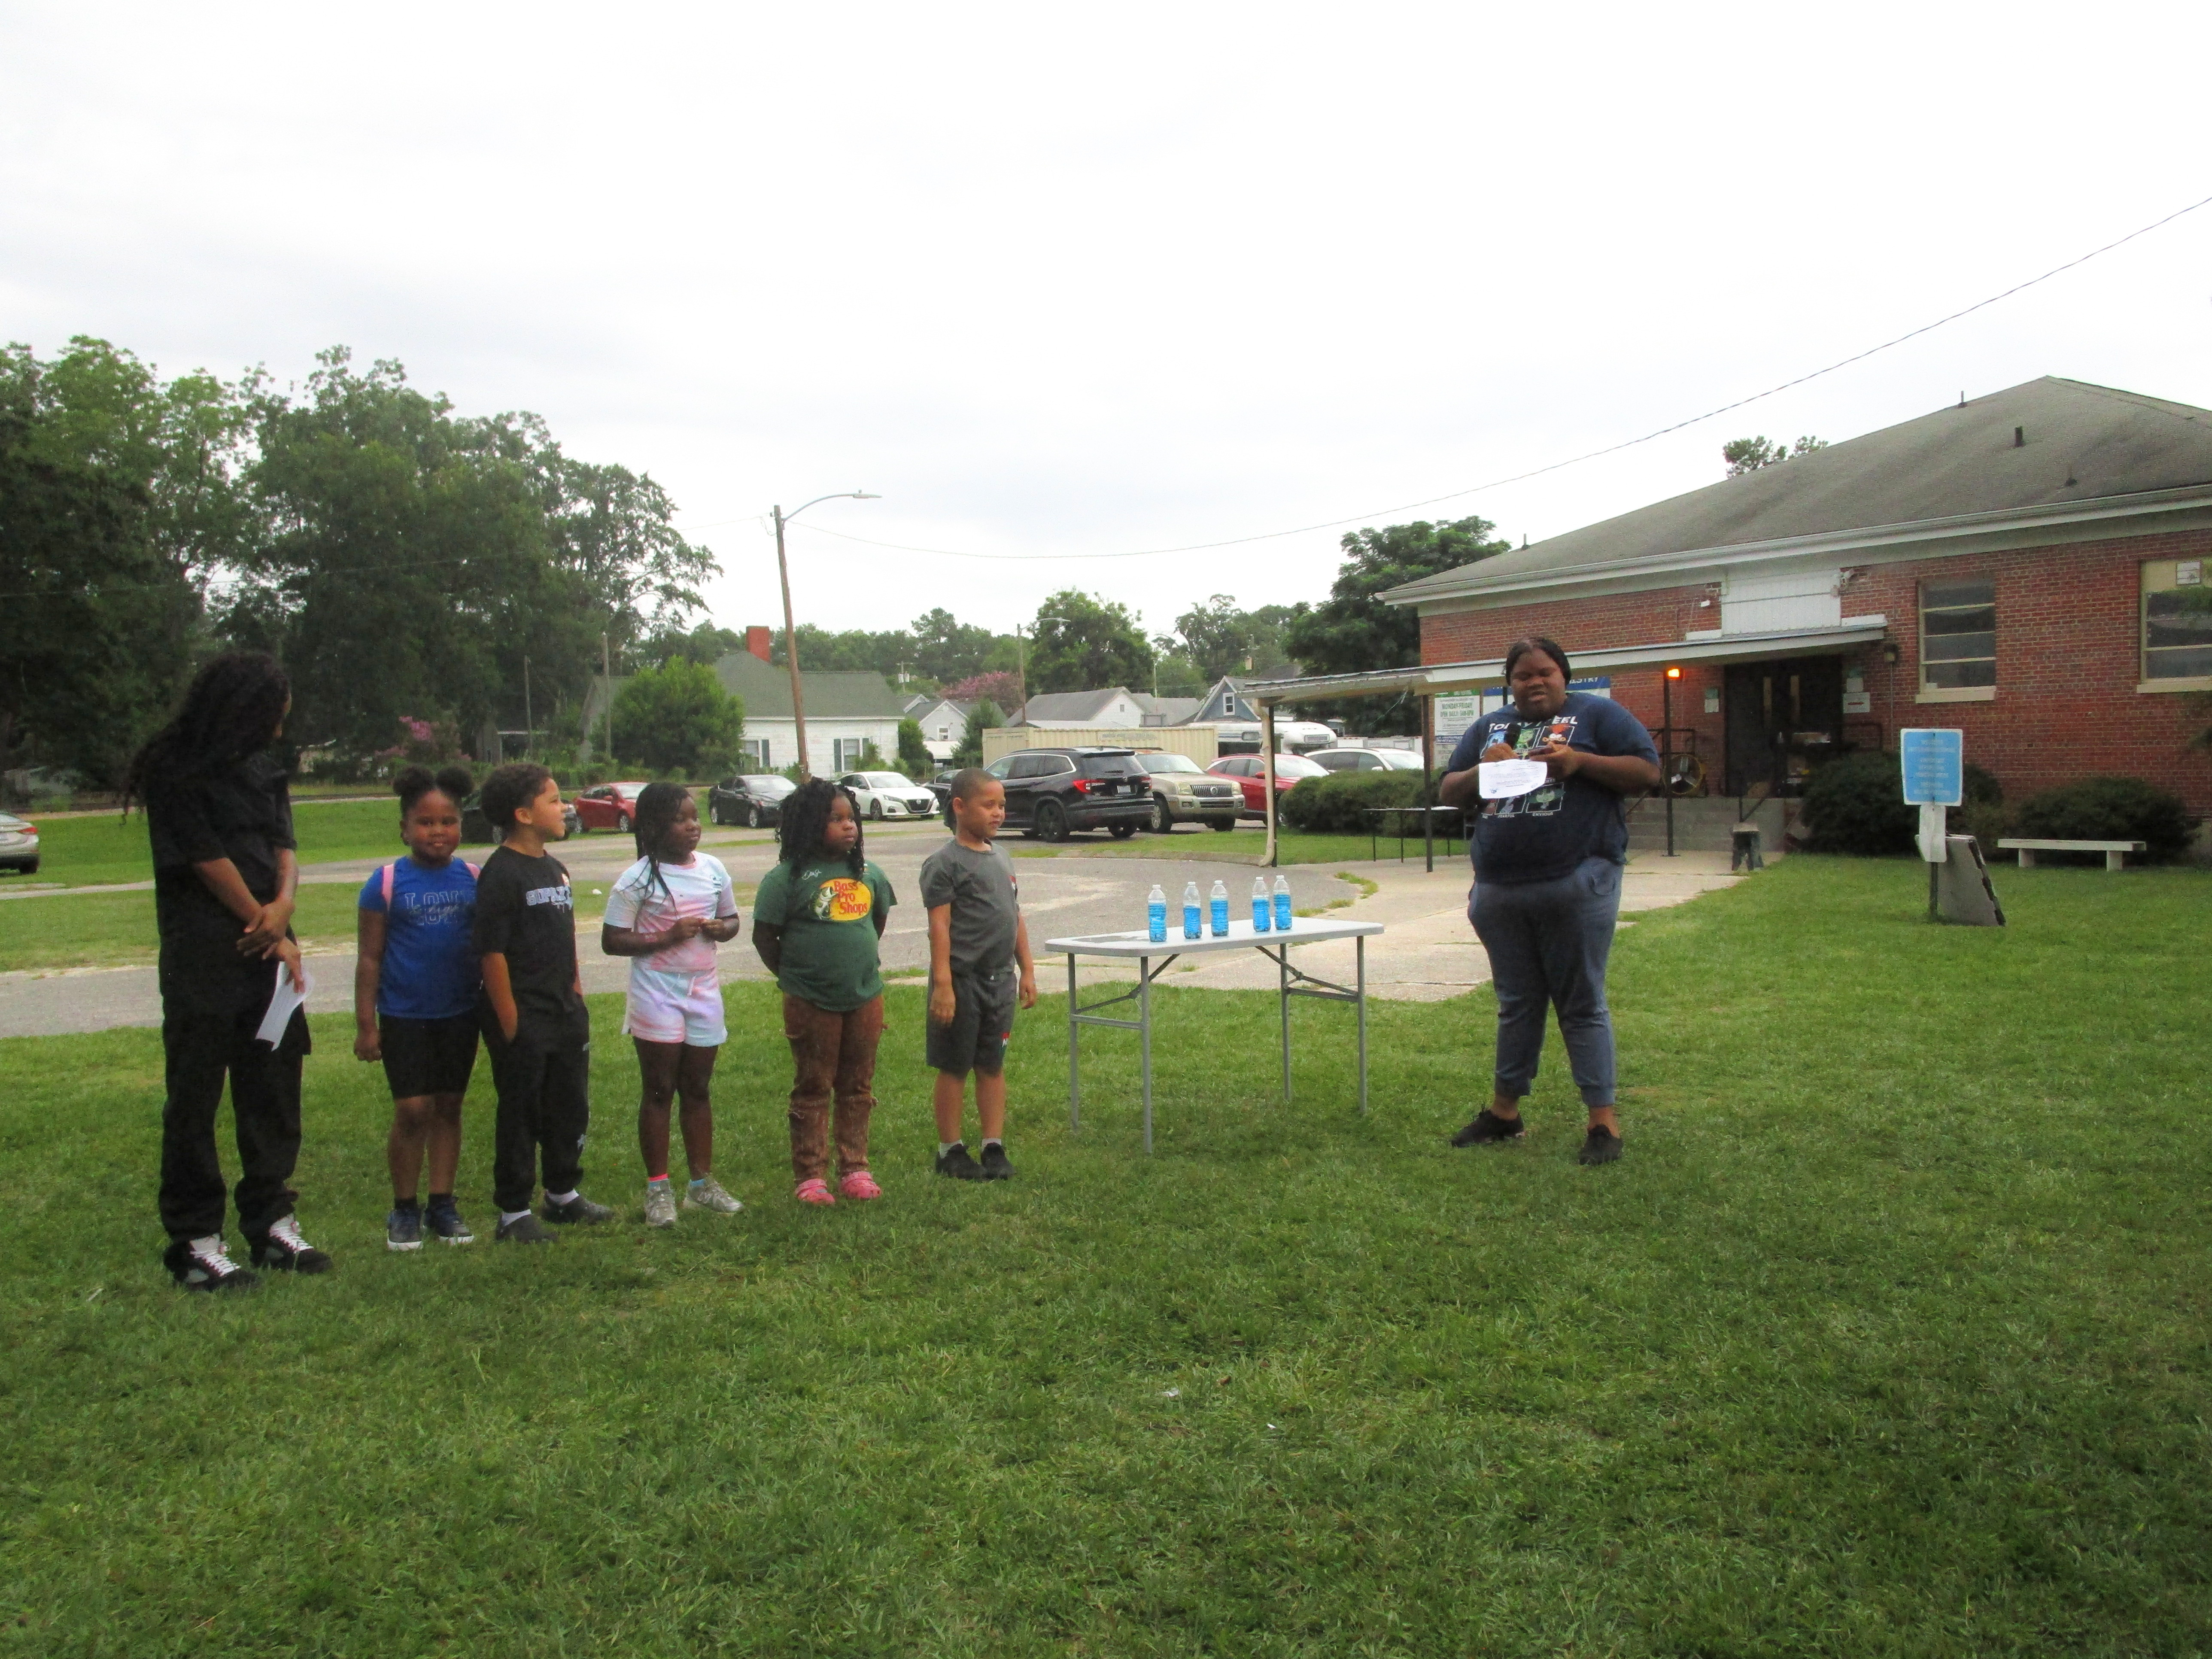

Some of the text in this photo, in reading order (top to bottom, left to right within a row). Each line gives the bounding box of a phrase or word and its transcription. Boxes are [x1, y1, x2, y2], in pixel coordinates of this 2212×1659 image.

[1547, 716, 1578, 725] EEL
[834, 881, 858, 892] Bass
[837, 891, 855, 902] Pro
[839, 902, 868, 915] Shops
